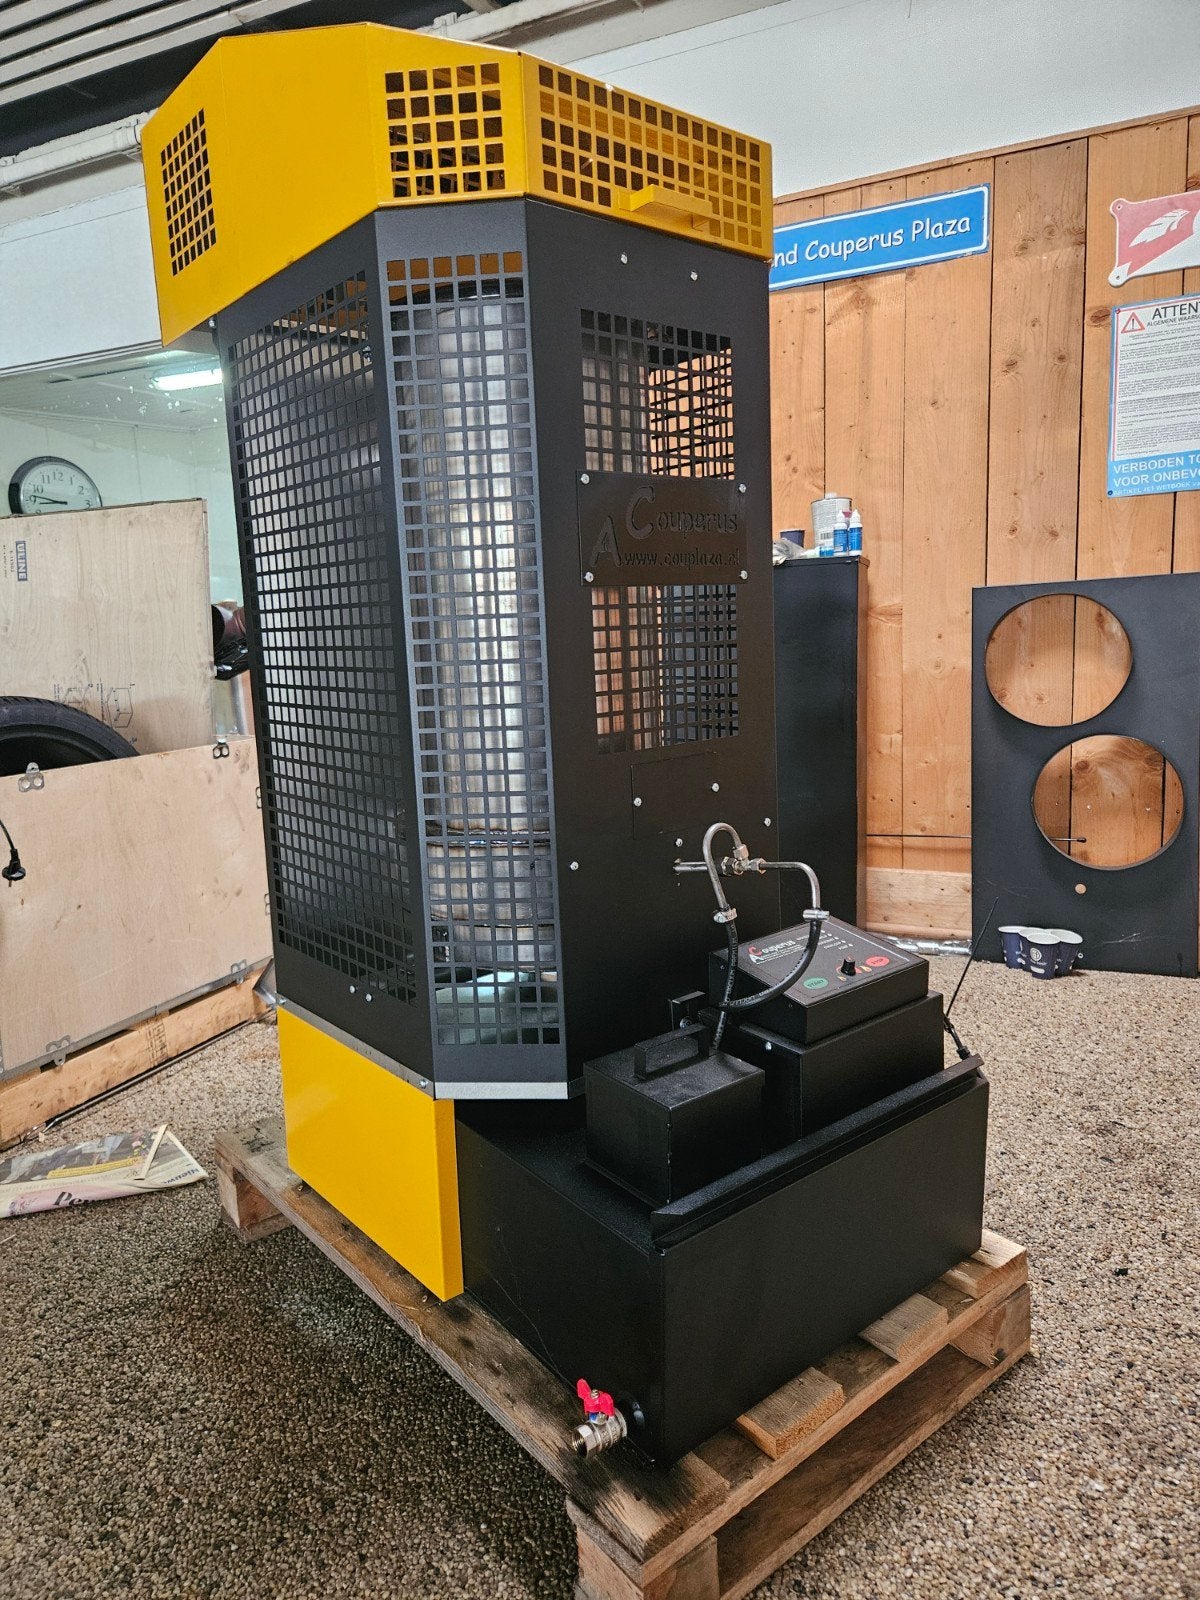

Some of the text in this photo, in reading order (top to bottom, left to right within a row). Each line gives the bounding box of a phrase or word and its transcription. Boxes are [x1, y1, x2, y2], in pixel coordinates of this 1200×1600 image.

[771, 216, 971, 268] nd Couperus Plaza
[1152, 301, 1200, 320] ATTEN
[1147, 317, 1177, 327] ALGEMENE
[1113, 456, 1185, 474] VERBODEN
[41, 474, 51, 484] 11
[52, 471, 64, 482] 12
[69, 476, 74, 485] 1
[1113, 474, 1149, 488] VOOR
[32, 484, 44, 494] 10
[77, 486, 85, 495] 2
[1113, 488, 1142, 496] ARTIKEL
[1155, 481, 1191, 491] WETBOEK
[625, 485, 739, 539] Couperus
[16, 542, 26, 581] ULINE
